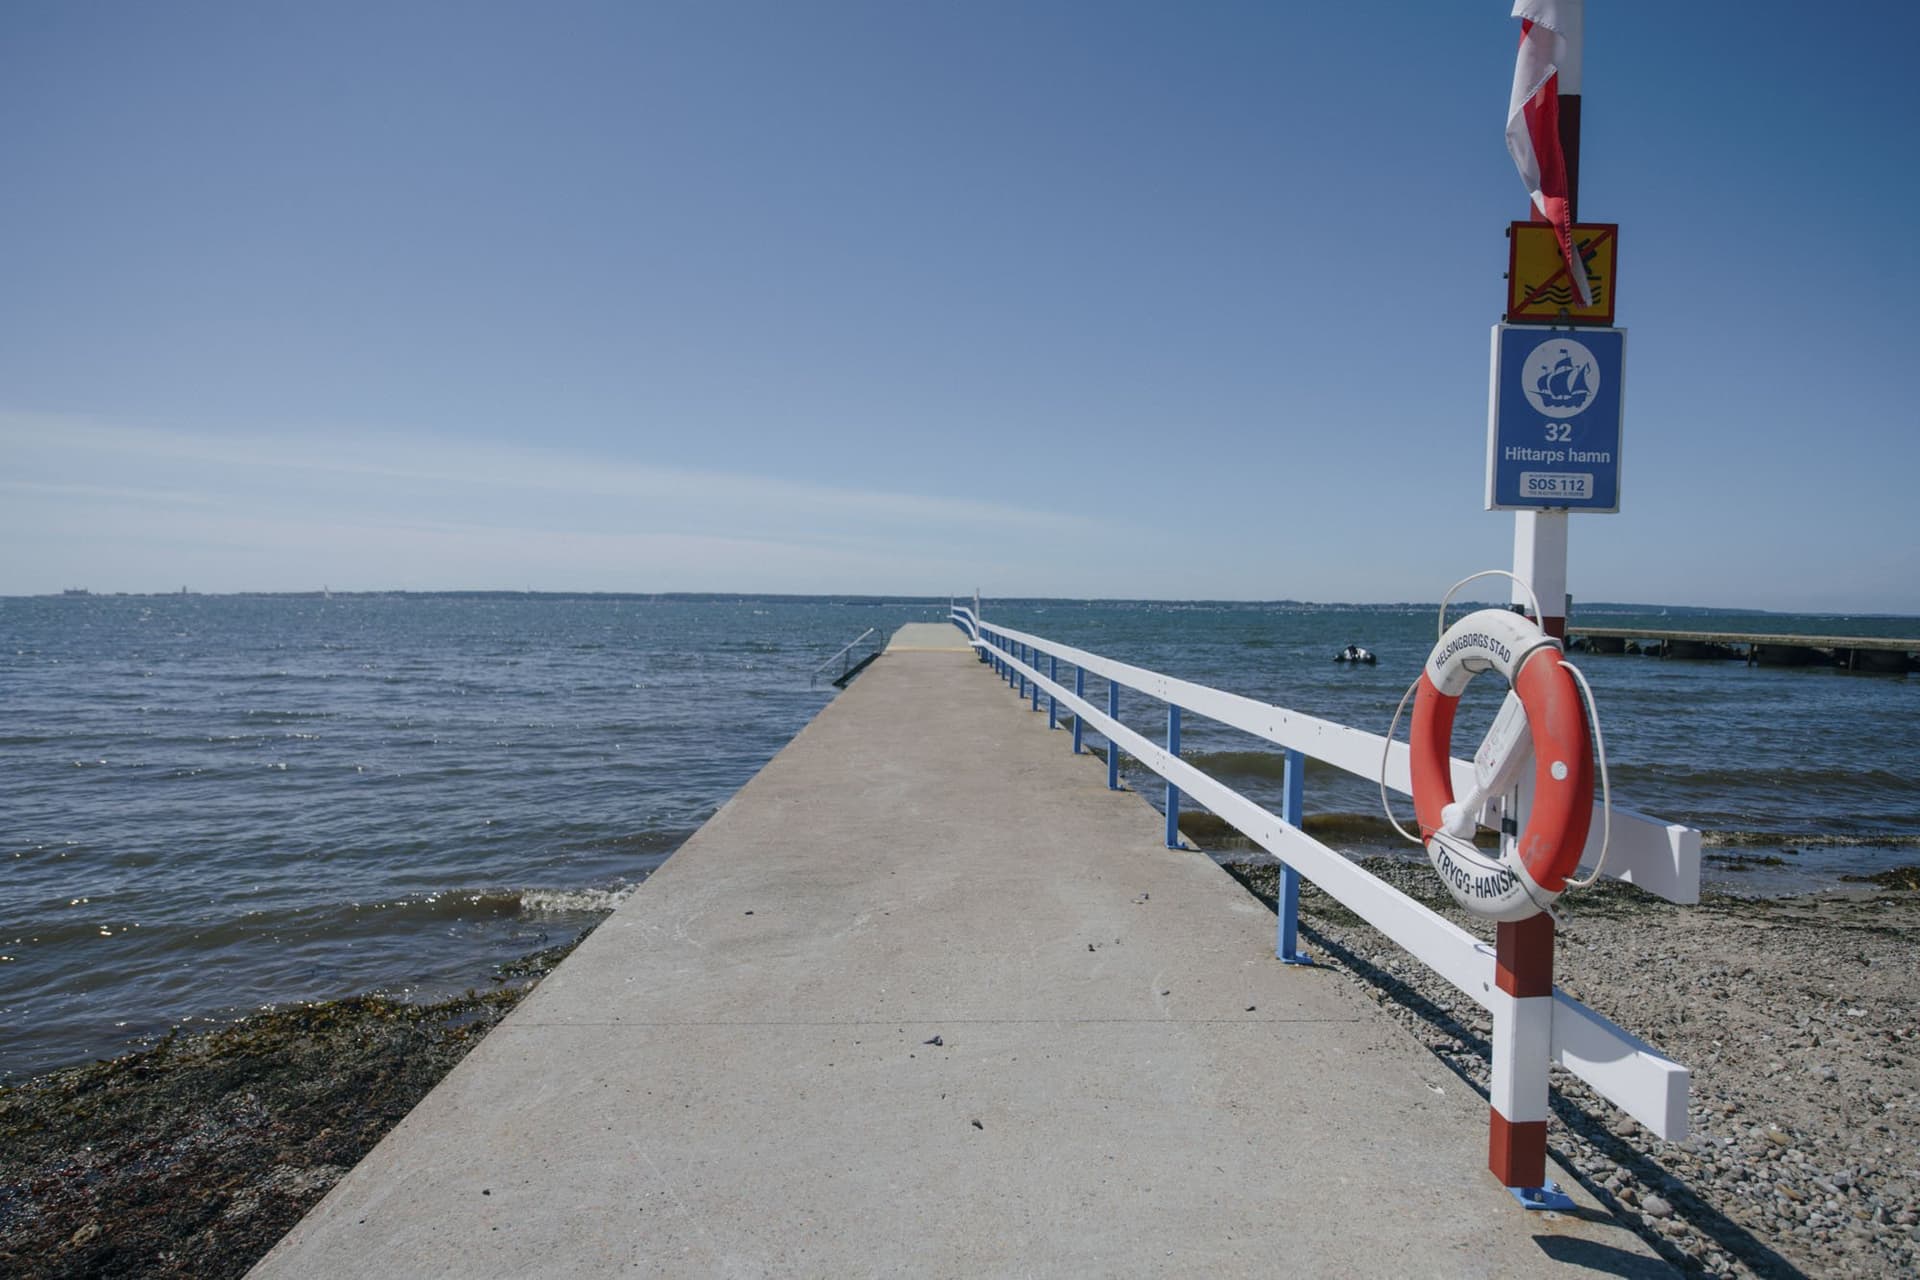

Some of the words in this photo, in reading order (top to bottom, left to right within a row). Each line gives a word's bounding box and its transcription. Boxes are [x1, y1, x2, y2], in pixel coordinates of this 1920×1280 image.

[1545, 423, 1572, 442] 32
[1505, 446, 1565, 464] Hittarps
[1568, 448, 1611, 463] hamn
[1528, 478, 1556, 490] SOS
[1560, 479, 1585, 492] 112
[1435, 633, 1489, 671] HELSINGBORGS
[1489, 638, 1511, 663] STAD
